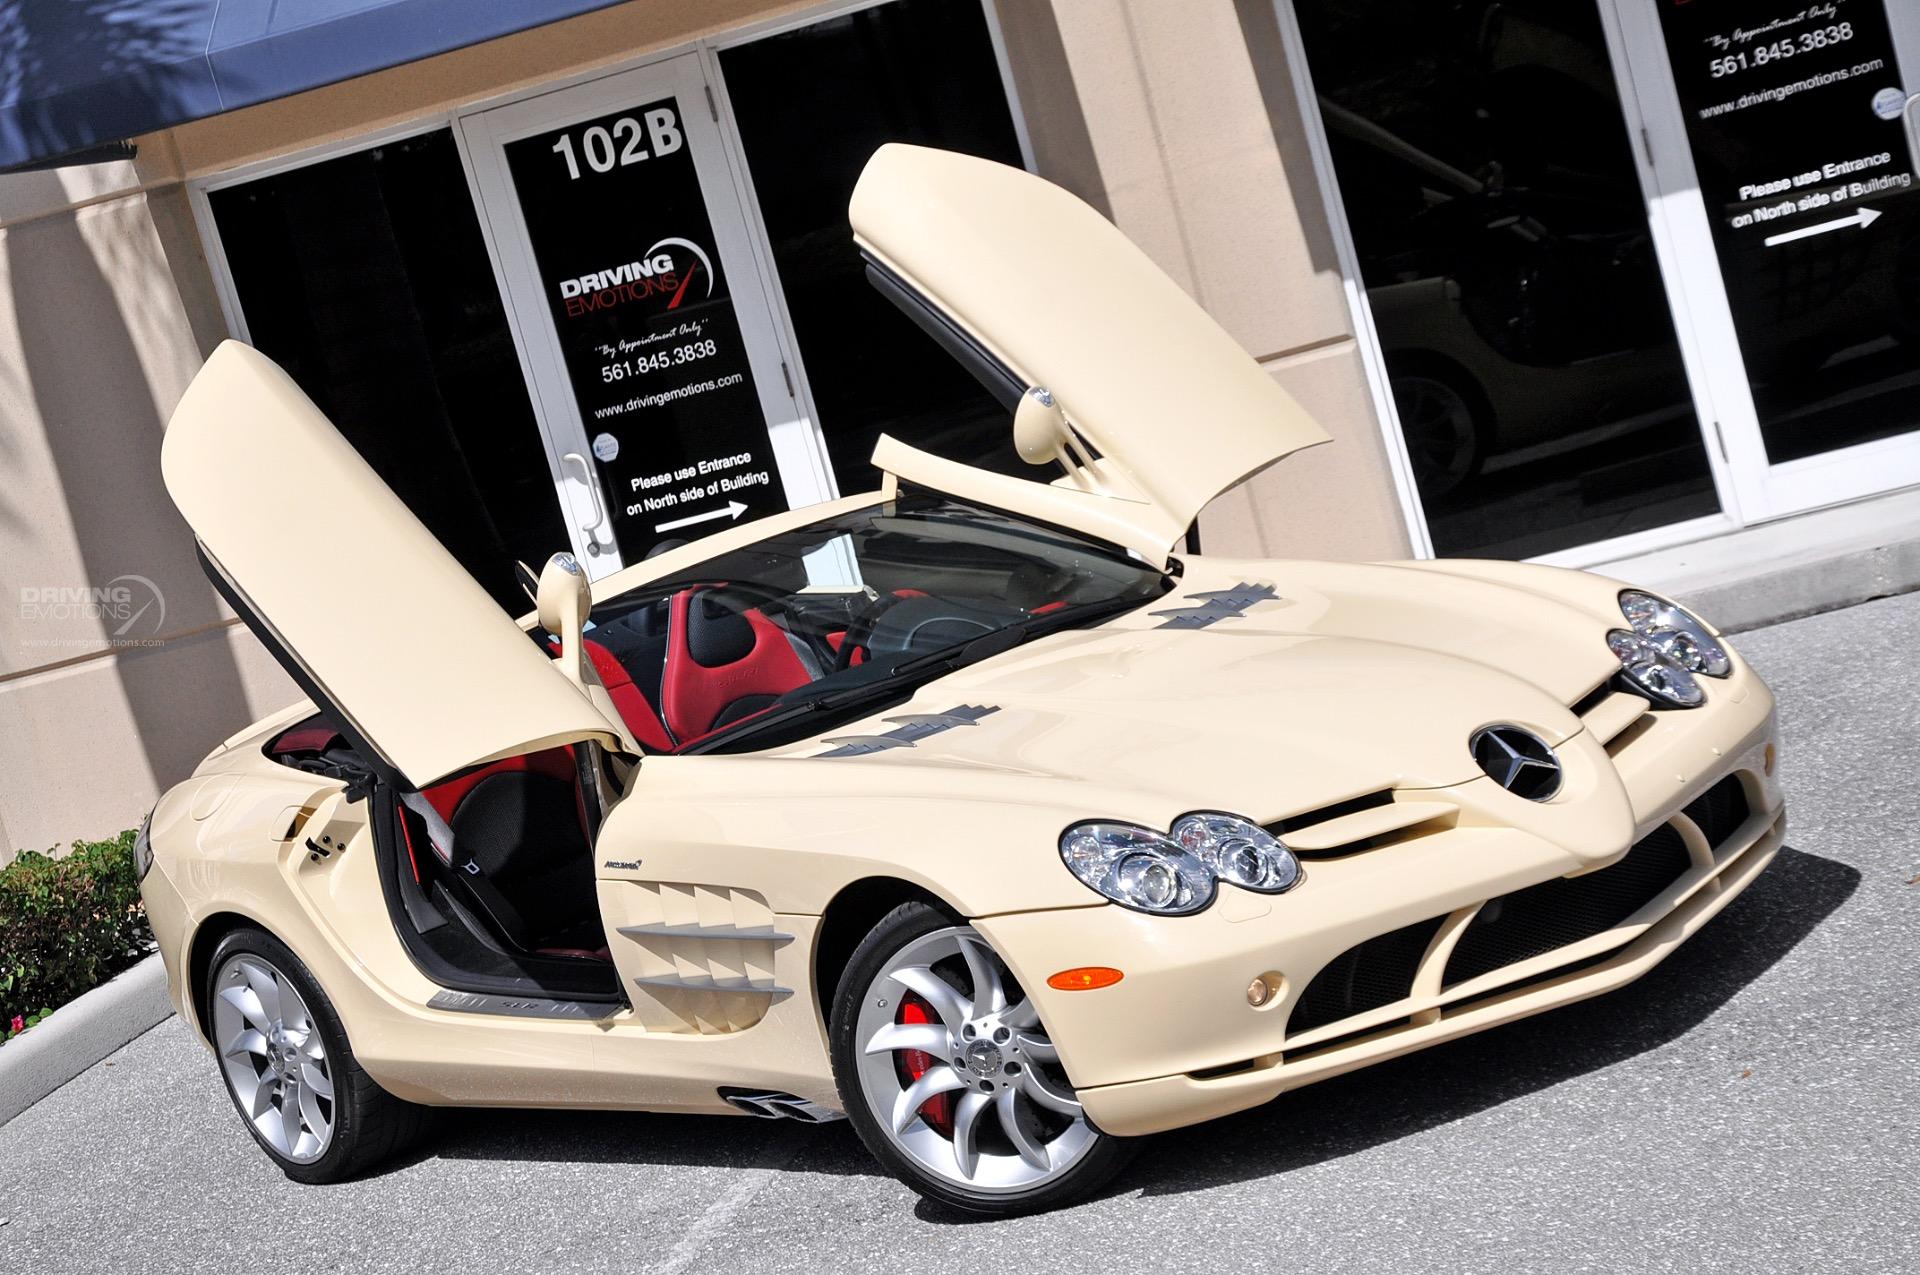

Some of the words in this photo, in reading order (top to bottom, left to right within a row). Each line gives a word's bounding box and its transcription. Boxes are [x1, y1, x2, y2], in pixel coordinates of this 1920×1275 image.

[1709, 21, 1853, 79] 561.845.3838
[1732, 10, 1807, 44] Appointment
[1700, 57, 1885, 120] www.drivingemotions.com
[552, 106, 683, 180] 102B
[1738, 178, 1793, 201] Please
[1792, 170, 1823, 187] use
[1822, 152, 1891, 179] Entrance
[1731, 213, 1754, 229] on
[1752, 200, 1798, 223] North
[1797, 192, 1831, 212] side
[1831, 185, 1850, 202] of
[1849, 172, 1911, 198] Building
[559, 253, 675, 299] DRIVING
[563, 272, 680, 318] EMOTIONS
[601, 338, 718, 383] 561.845.3838
[619, 327, 678, 353] Appointment
[595, 372, 743, 419] www.drivingemotions.com
[626, 503, 643, 517] on
[643, 492, 679, 513] North
[679, 486, 705, 503] side
[706, 480, 719, 496] of
[720, 470, 770, 493] Building
[630, 472, 673, 492] Please
[673, 465, 697, 481] use
[697, 451, 752, 475] Entrance
